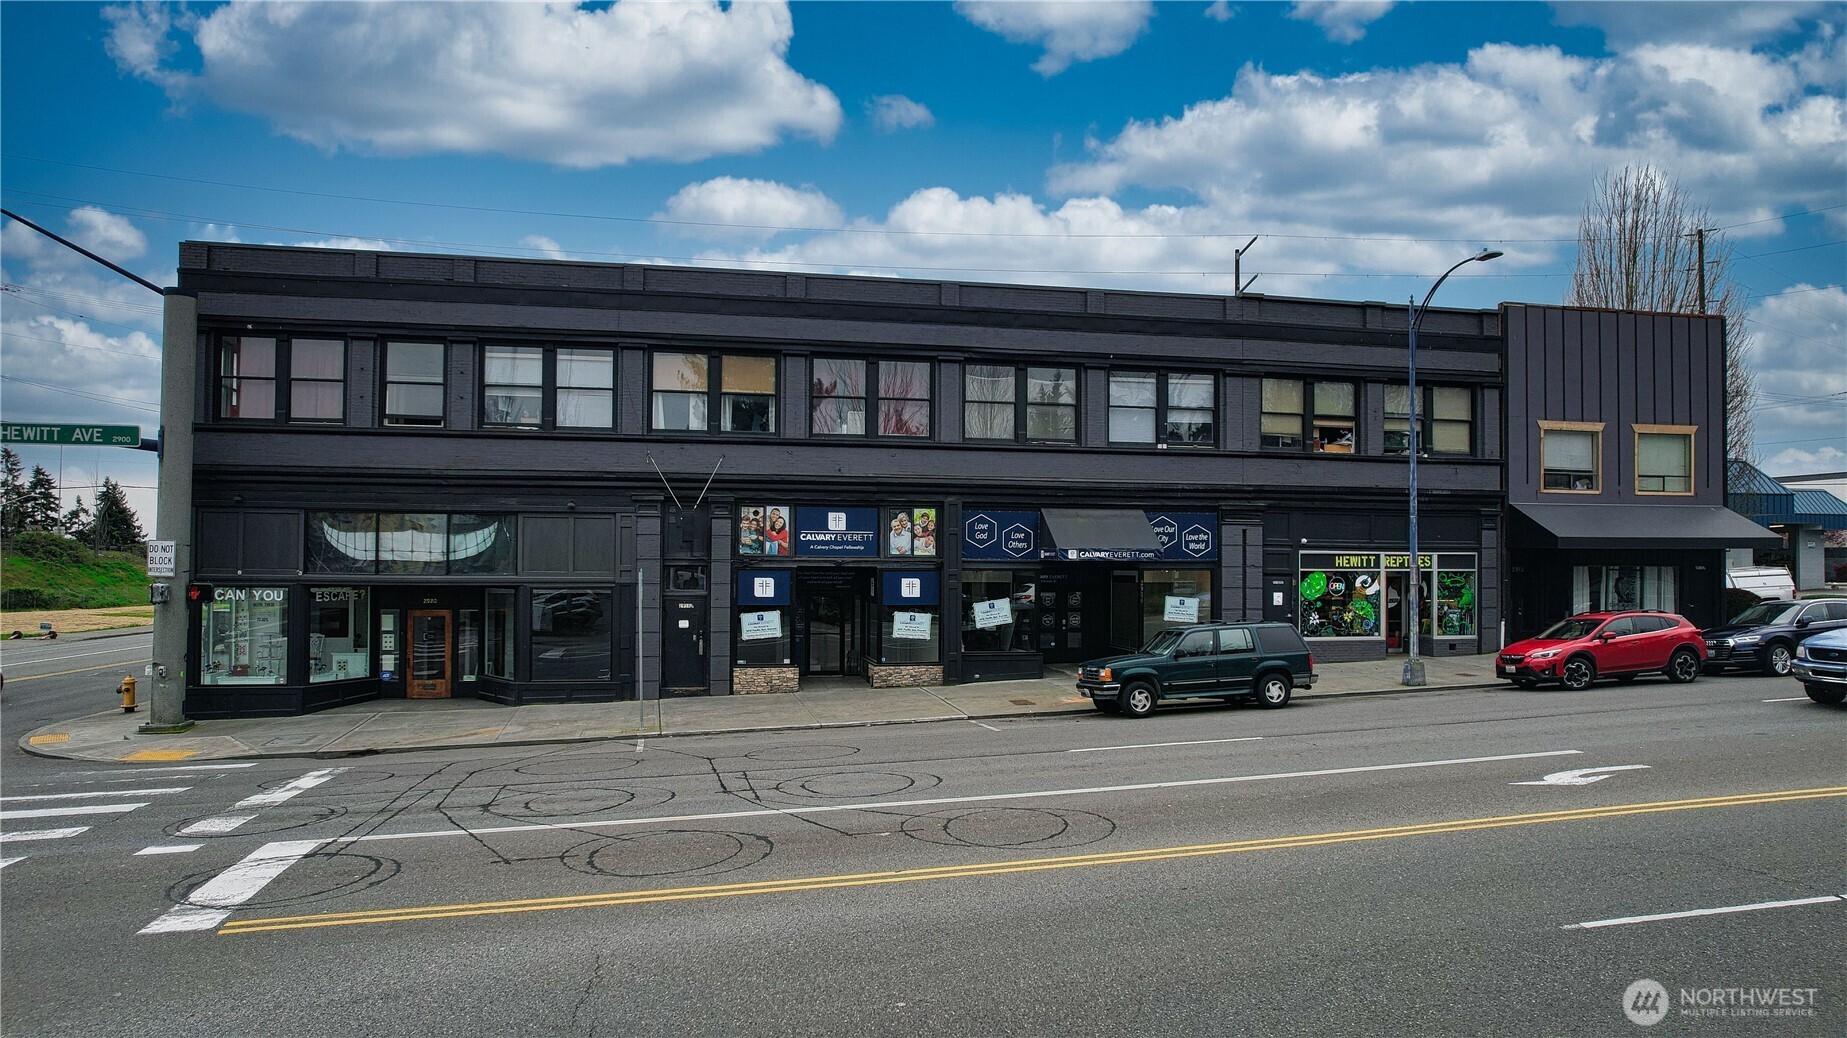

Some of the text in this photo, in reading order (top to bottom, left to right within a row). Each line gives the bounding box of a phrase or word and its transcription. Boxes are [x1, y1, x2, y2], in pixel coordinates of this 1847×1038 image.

[0, 426, 131, 443] HEWITT AVE 2900
[974, 522, 989, 530] Love
[1151, 525, 1175, 533] ove Our
[800, 533, 874, 542] CALVARY EVERETT
[975, 531, 988, 540] God
[1011, 531, 1025, 539] Love
[1157, 534, 1169, 543] City
[1185, 533, 1208, 541] Love the
[149, 544, 174, 553] DO NOT
[1007, 540, 1028, 549] Others
[1188, 542, 1206, 550] World
[149, 556, 173, 565] BLOCK
[1335, 555, 1431, 567] HEWITT REPTES
[1329, 582, 1345, 590] OPEN
[214, 589, 284, 601] CAN YOU
